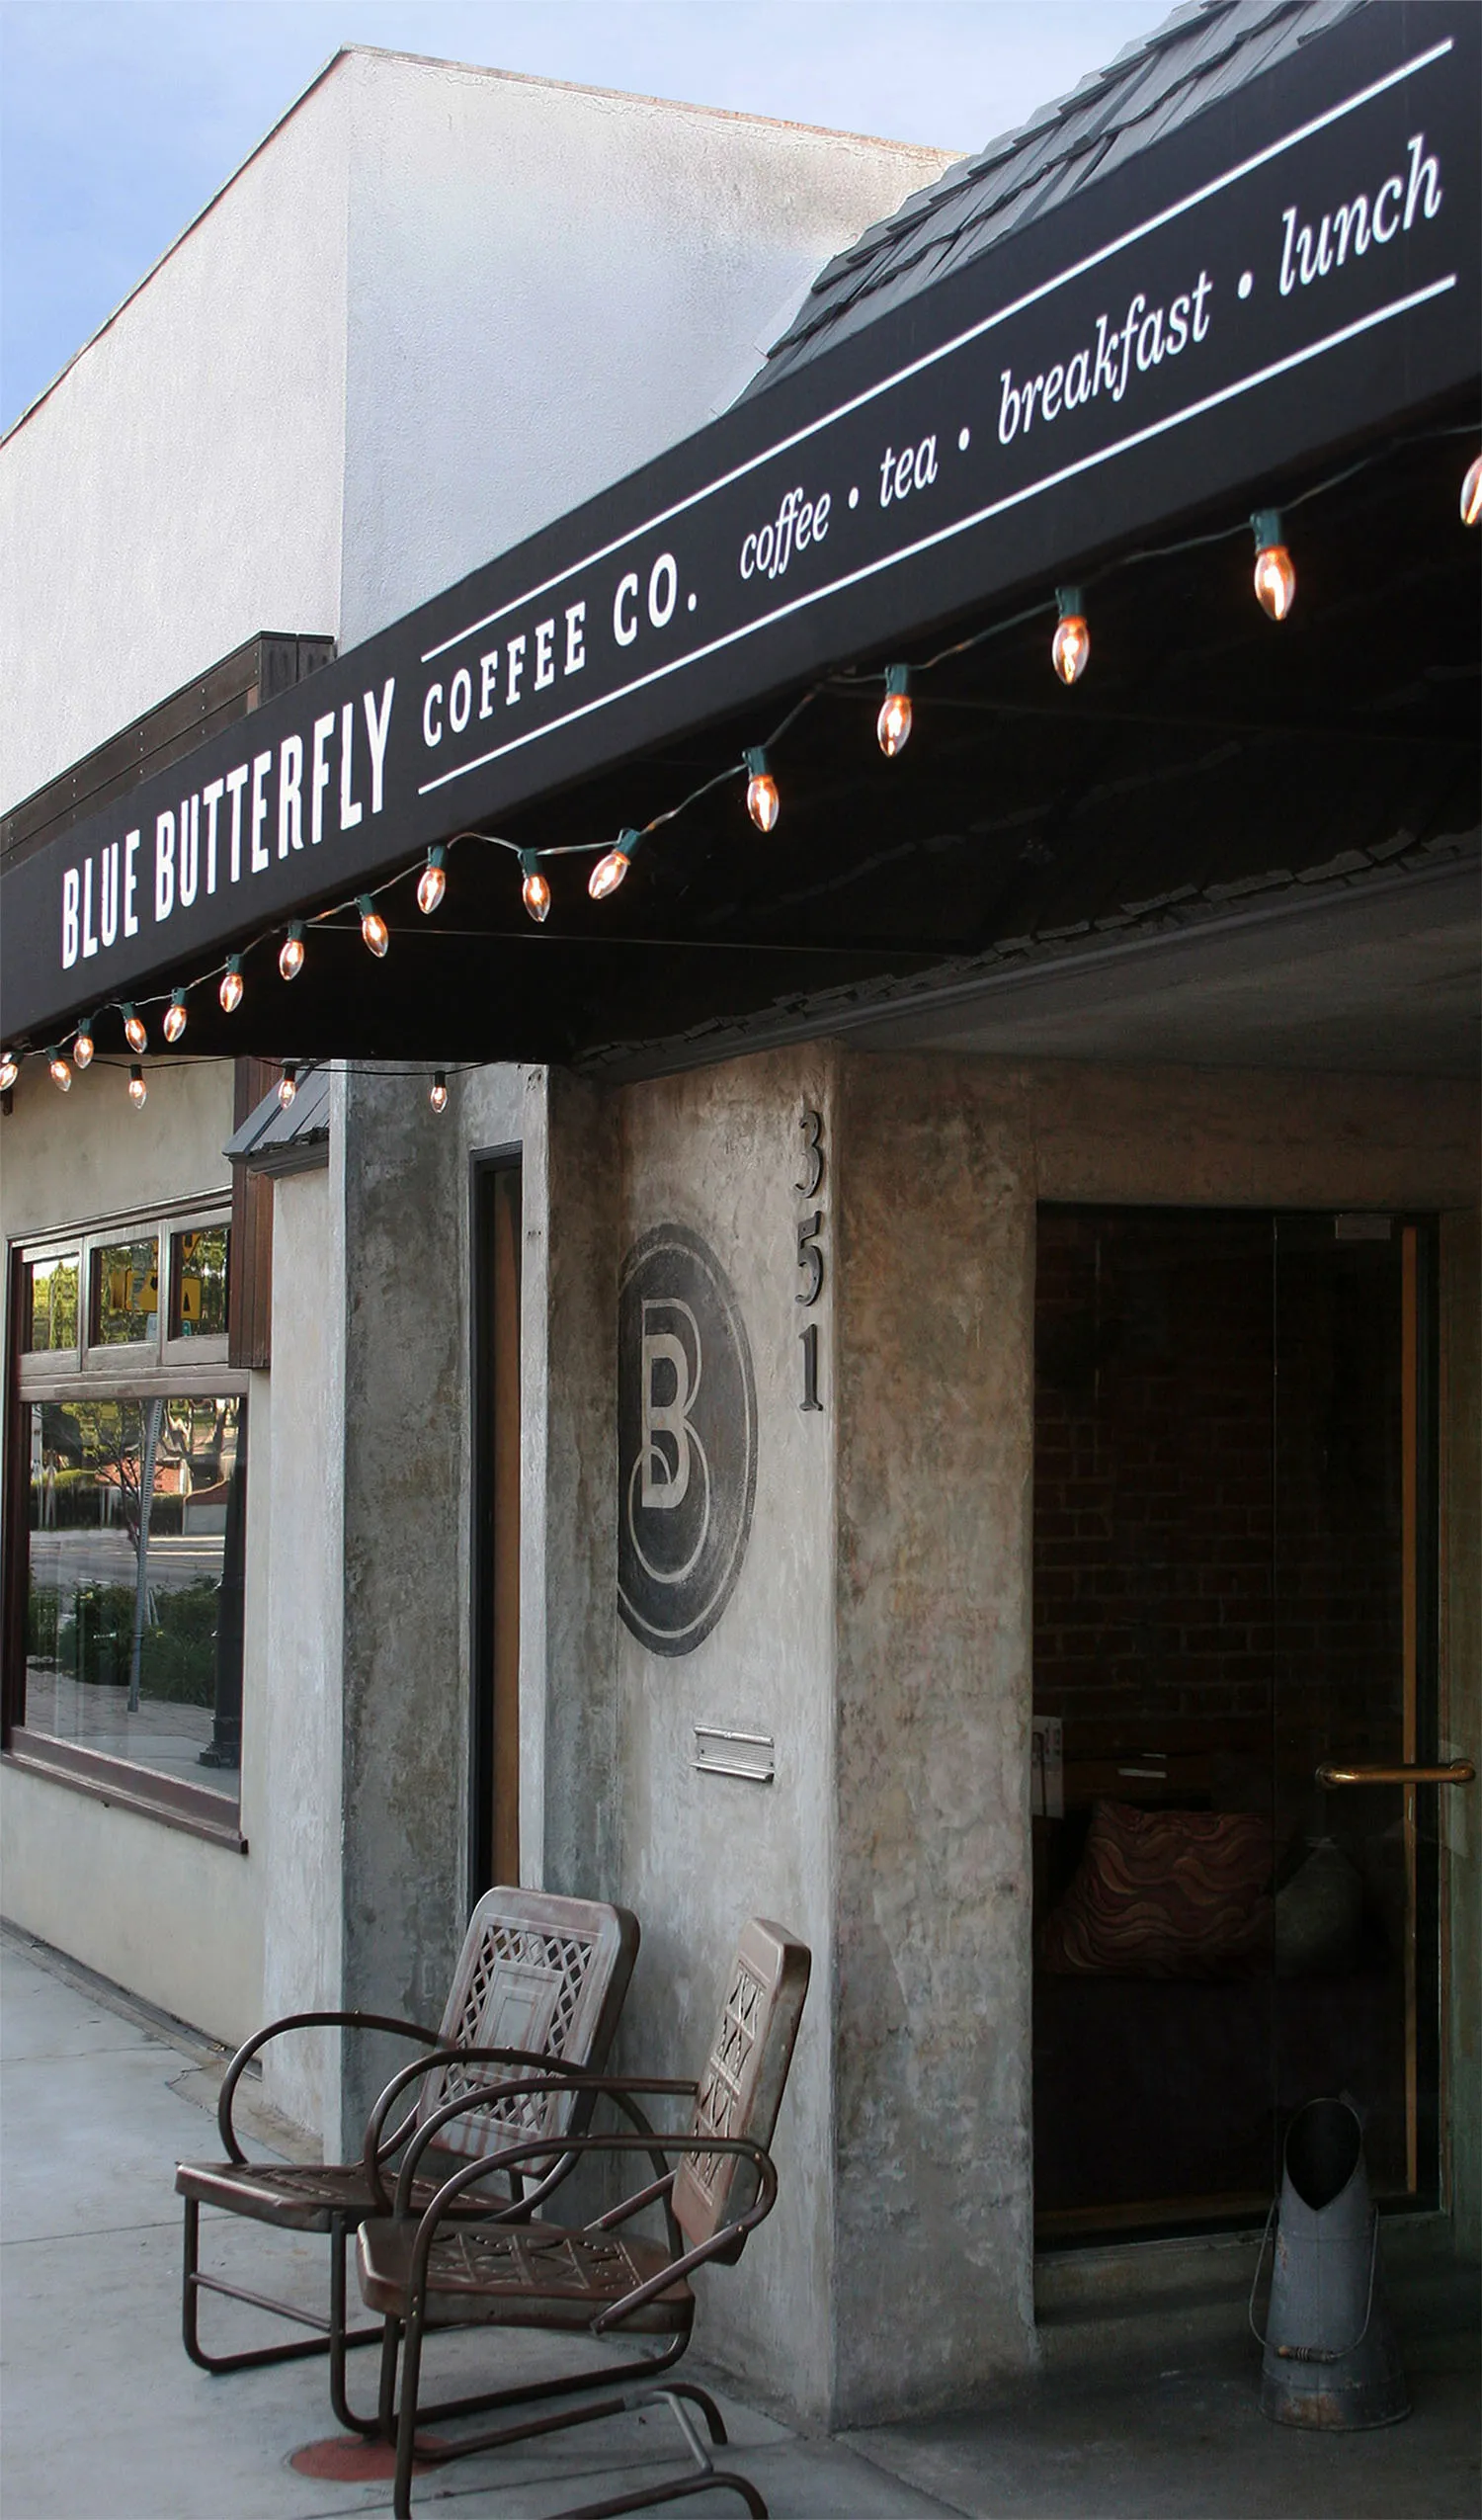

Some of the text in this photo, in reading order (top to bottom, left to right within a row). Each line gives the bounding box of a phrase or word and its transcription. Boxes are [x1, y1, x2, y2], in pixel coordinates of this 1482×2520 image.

[739, 133, 1442, 580] coffee tea breakfast lunch
[61, 551, 699, 970] BLUE BUTTERFLY COFFEE CO.
